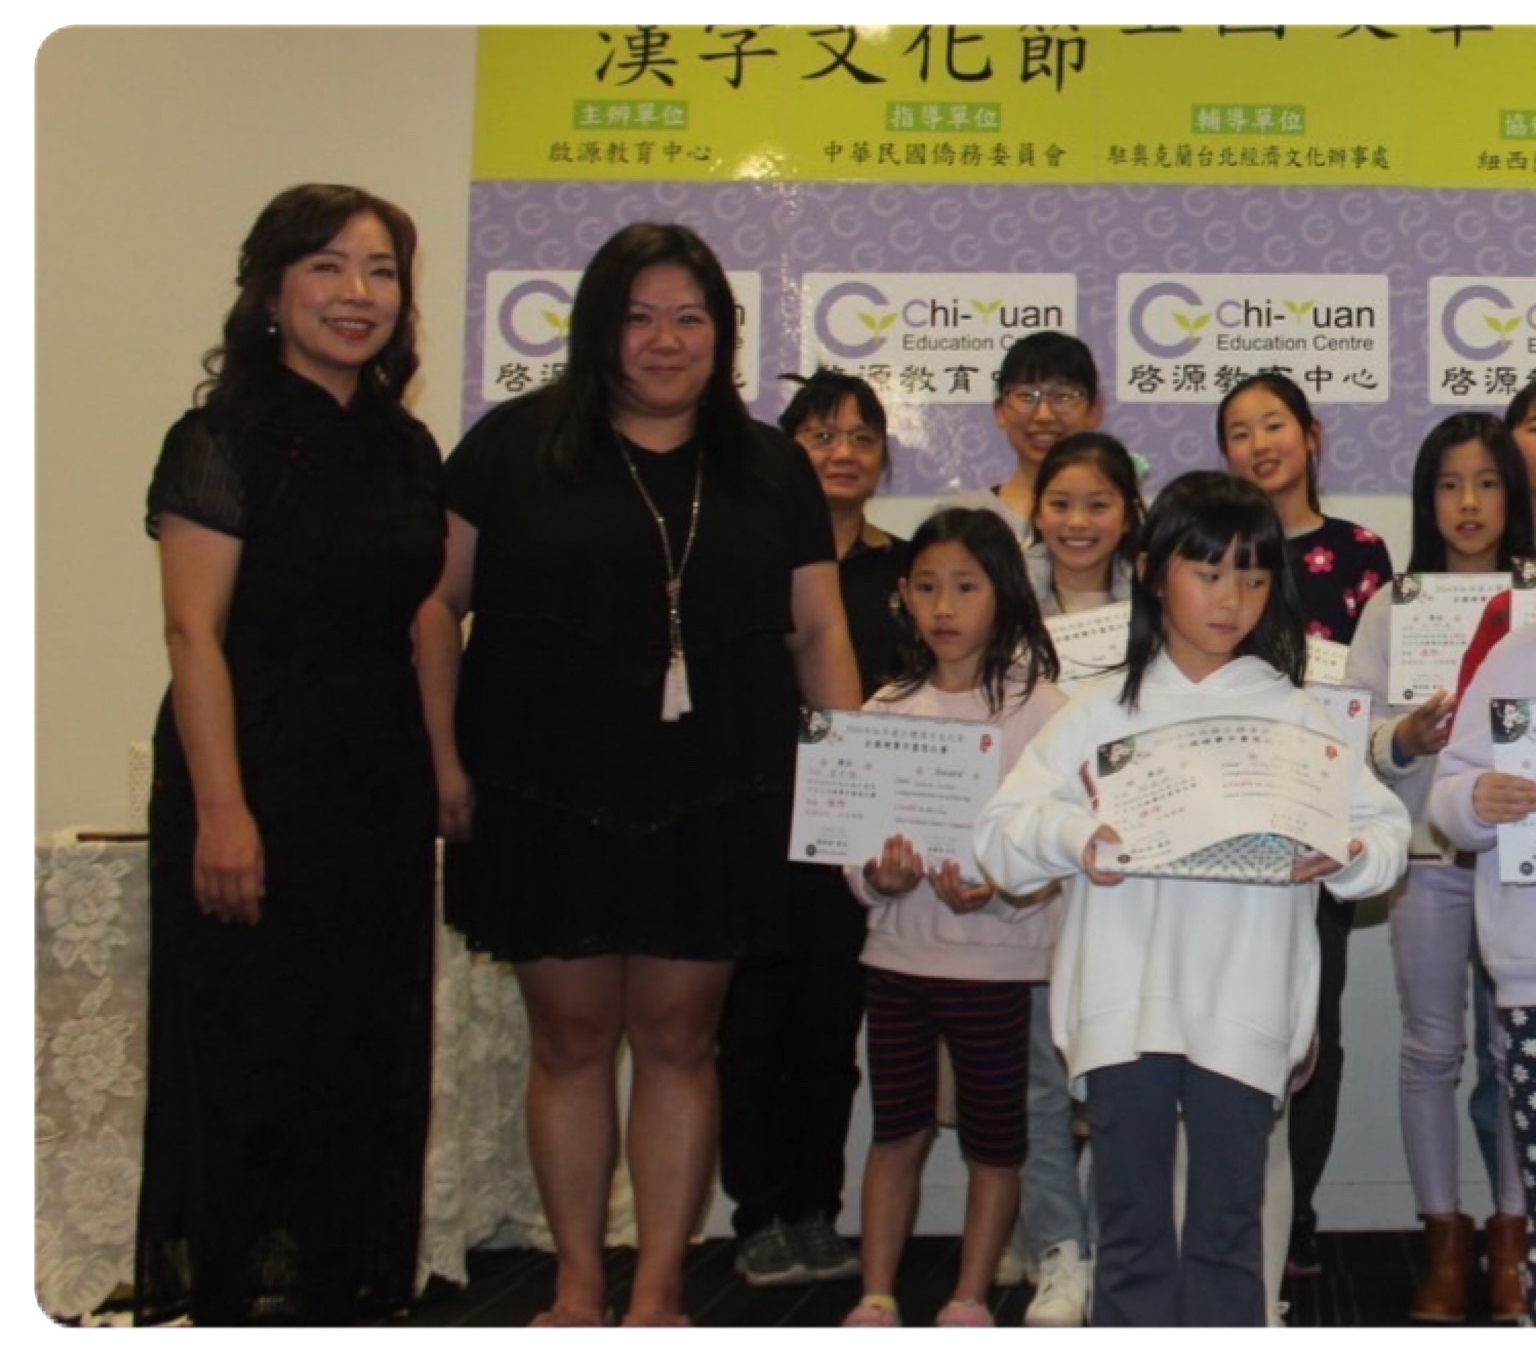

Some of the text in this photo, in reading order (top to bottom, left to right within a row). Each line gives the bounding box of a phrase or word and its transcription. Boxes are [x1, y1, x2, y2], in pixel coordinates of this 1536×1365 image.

[595, 25, 1090, 93] 漢字文化節
[890, 104, 1001, 129] 指導單位
[823, 141, 1067, 168] 中華民國僑務委員會
[902, 298, 1063, 328] Chi-Yuan
[1216, 298, 1376, 329] Chi-Yuan
[903, 333, 994, 352] Education
[1216, 333, 1375, 352] Education Centre
